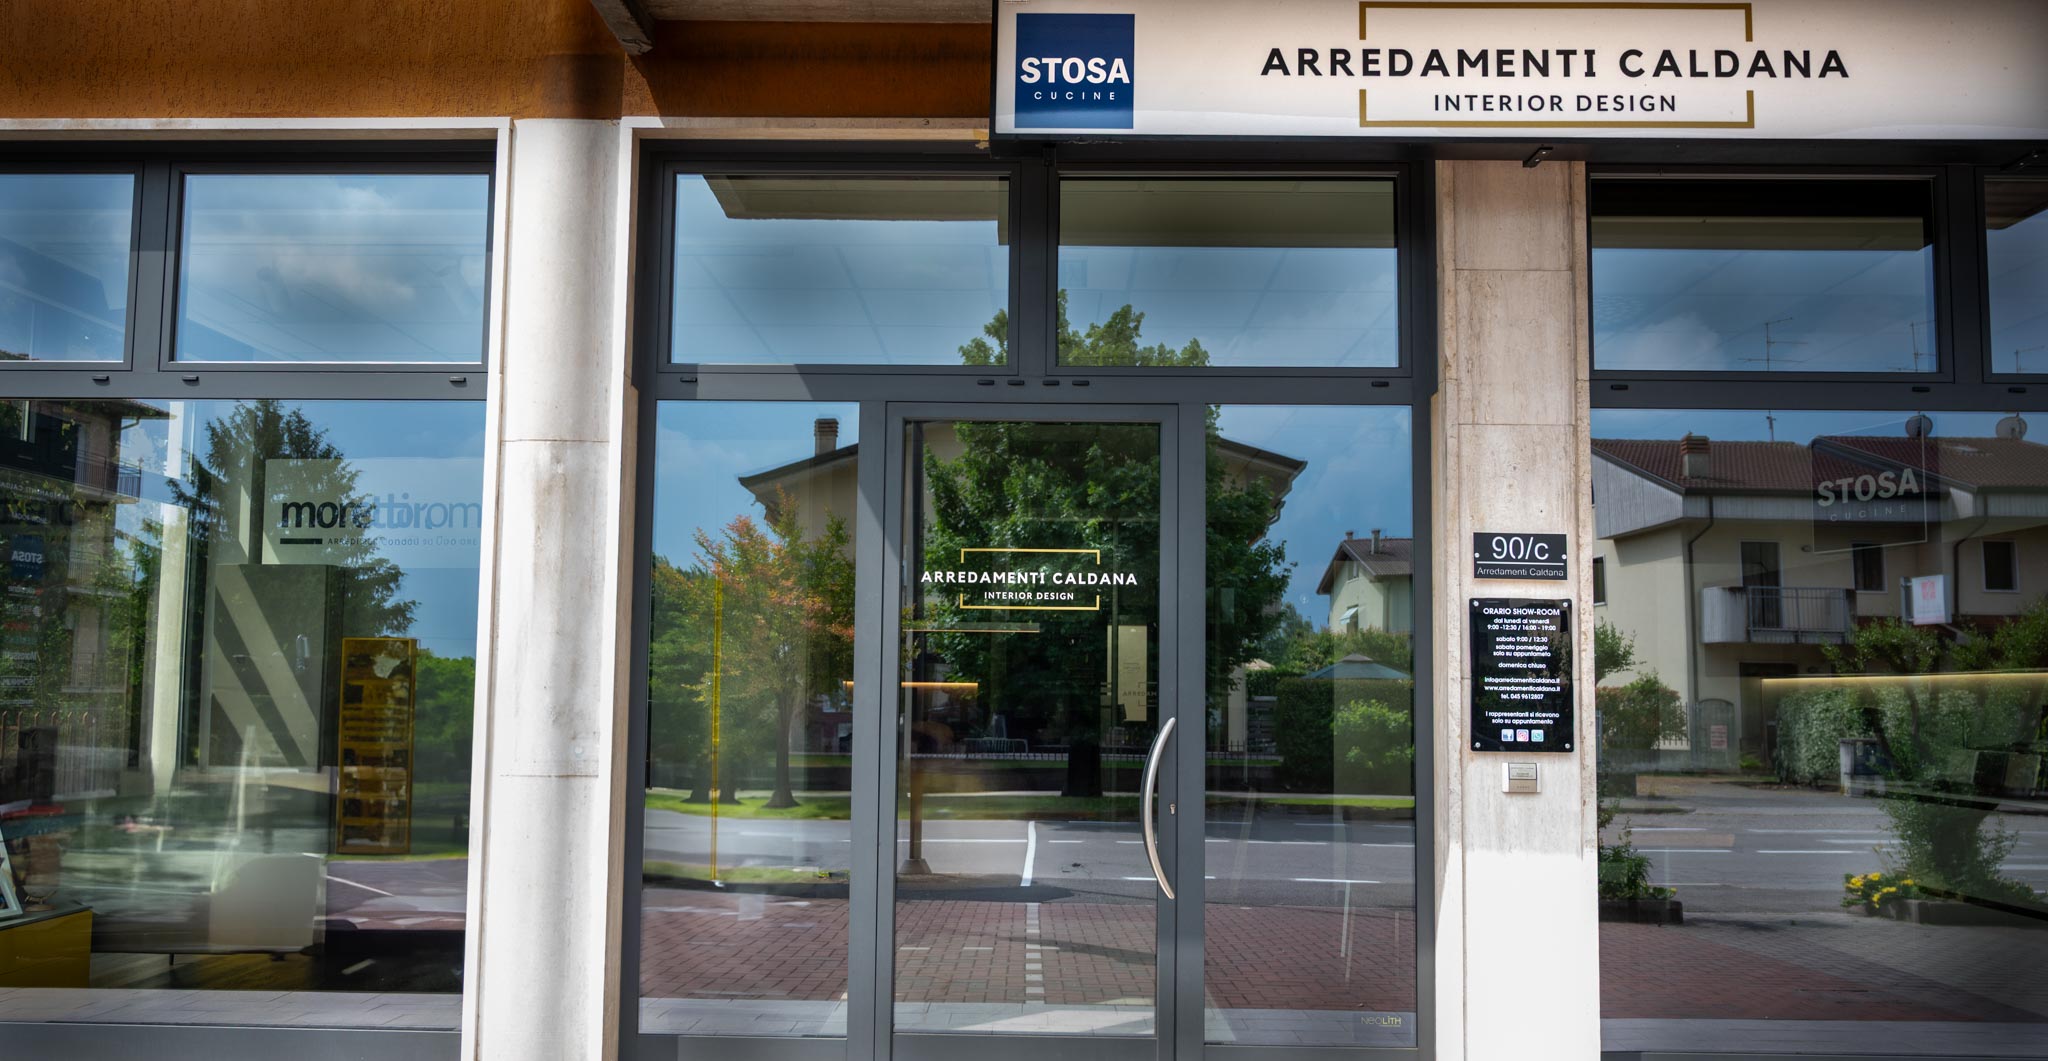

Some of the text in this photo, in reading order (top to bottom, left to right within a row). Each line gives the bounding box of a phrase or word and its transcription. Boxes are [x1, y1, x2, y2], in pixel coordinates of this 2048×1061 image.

[1020, 57, 1130, 84] STOSA
[1261, 48, 1849, 78] ARREDAMENTI CALDANA
[1034, 91, 1115, 100] CUCINE
[1434, 94, 1676, 112] INTERIOR DESIGN
[1817, 468, 1920, 507] STOSA
[1830, 505, 1905, 521] CUCINE
[1492, 536, 1549, 560] 90/c
[921, 571, 1138, 586] ARREDAMENTI CALDANA
[1477, 567, 1564, 576] Arredamenti Caldana
[984, 591, 1074, 600] INTERIOR DESIGN
[1483, 607, 1511, 615] ORARIO
